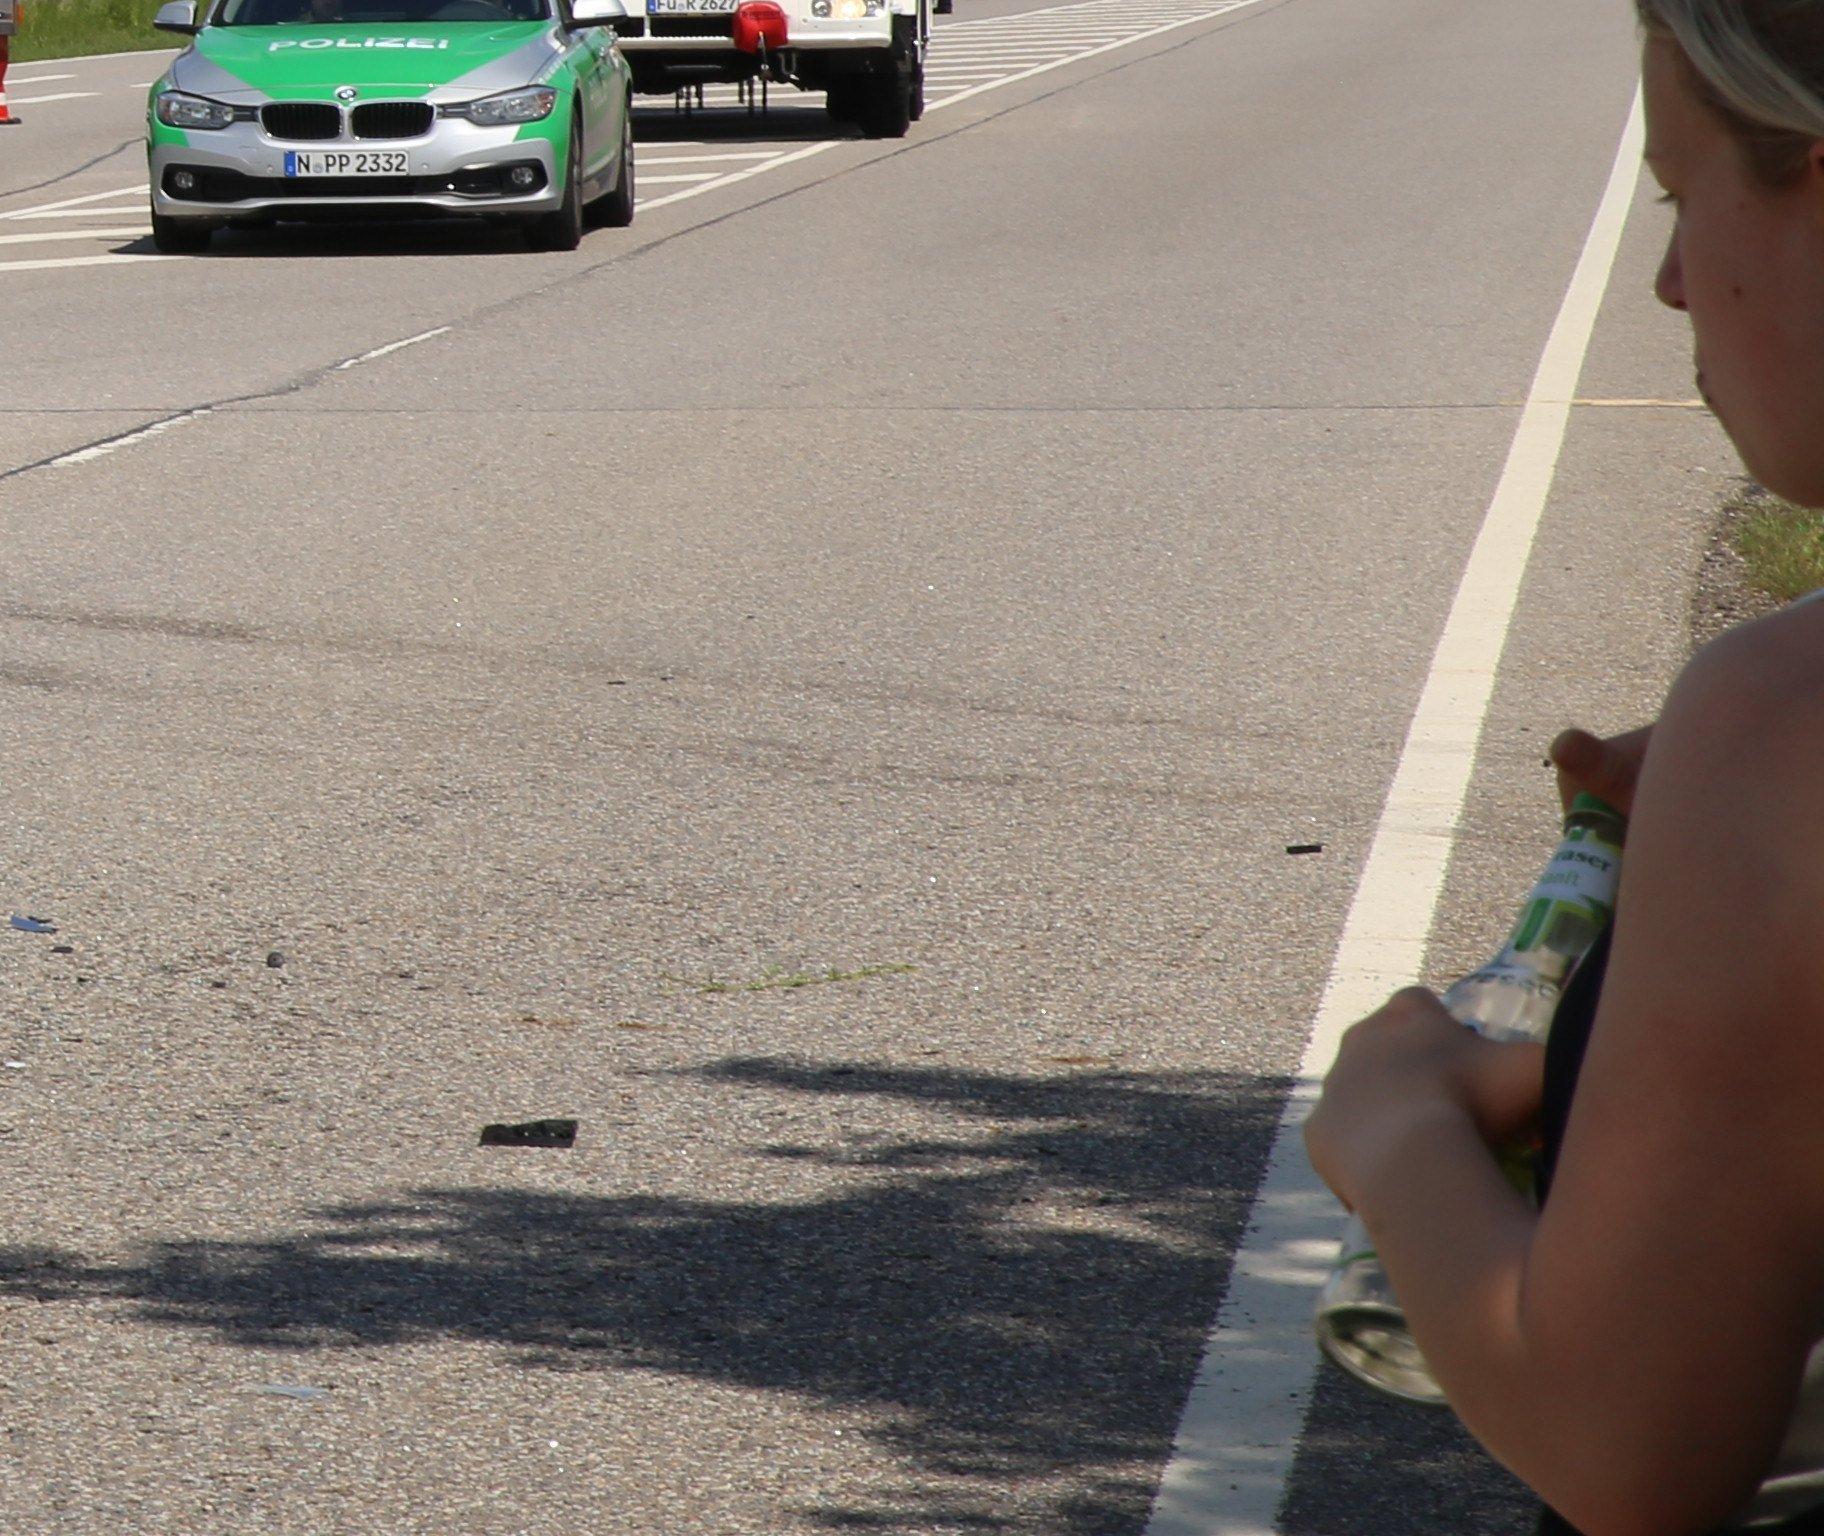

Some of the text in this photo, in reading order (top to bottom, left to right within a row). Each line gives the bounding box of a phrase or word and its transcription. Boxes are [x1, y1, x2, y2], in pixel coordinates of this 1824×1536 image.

[268, 36, 449, 53] POLIZEI
[297, 152, 407, 175] N PP 2332
